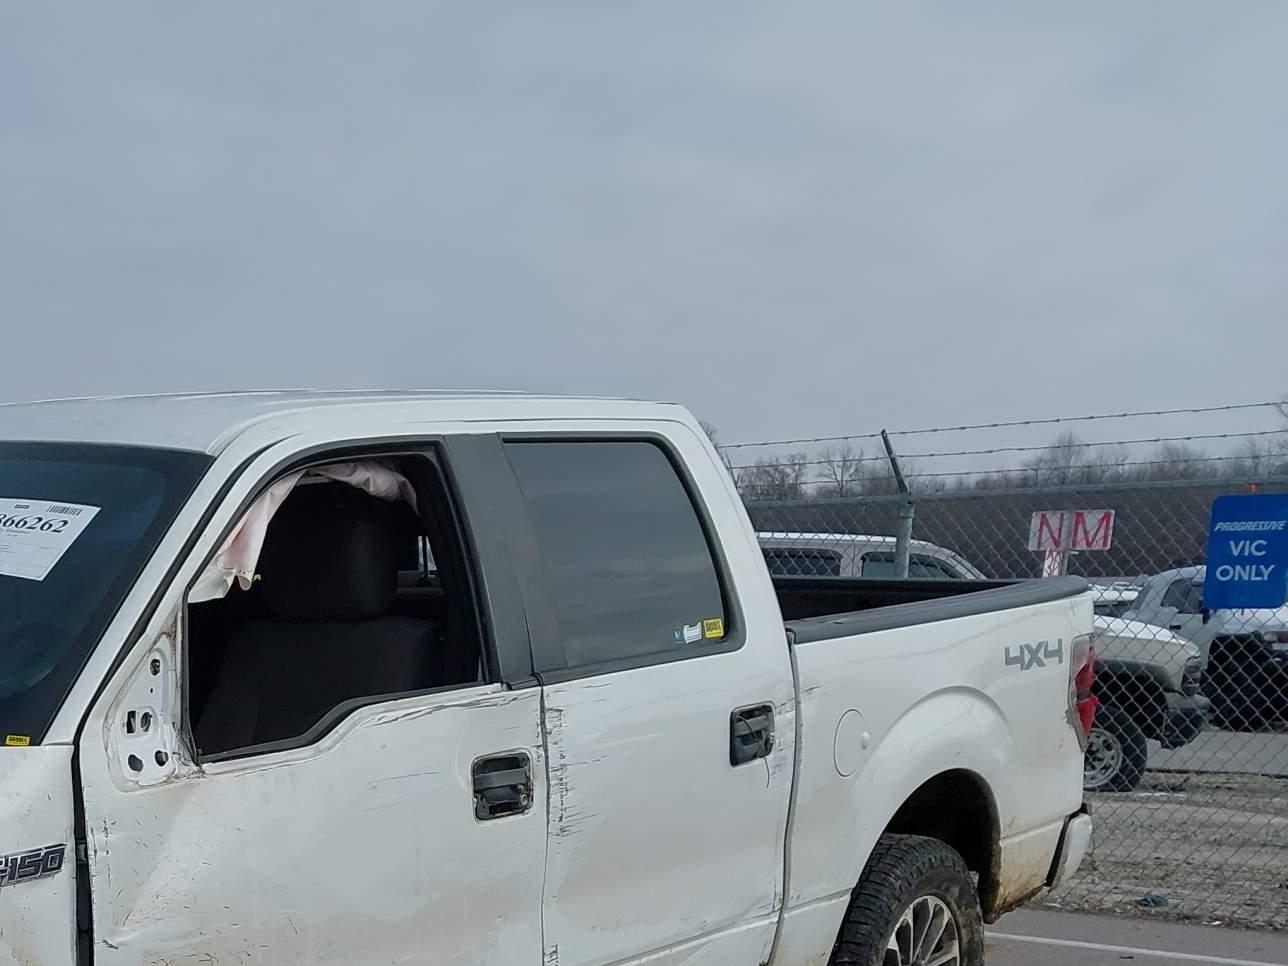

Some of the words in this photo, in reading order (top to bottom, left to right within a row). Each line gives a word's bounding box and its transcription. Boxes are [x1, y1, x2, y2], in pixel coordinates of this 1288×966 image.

[1213, 520, 1287, 532] PROGRESSIVE
[1229, 539, 1268, 557] VIC
[1215, 564, 1276, 582] ONLY
